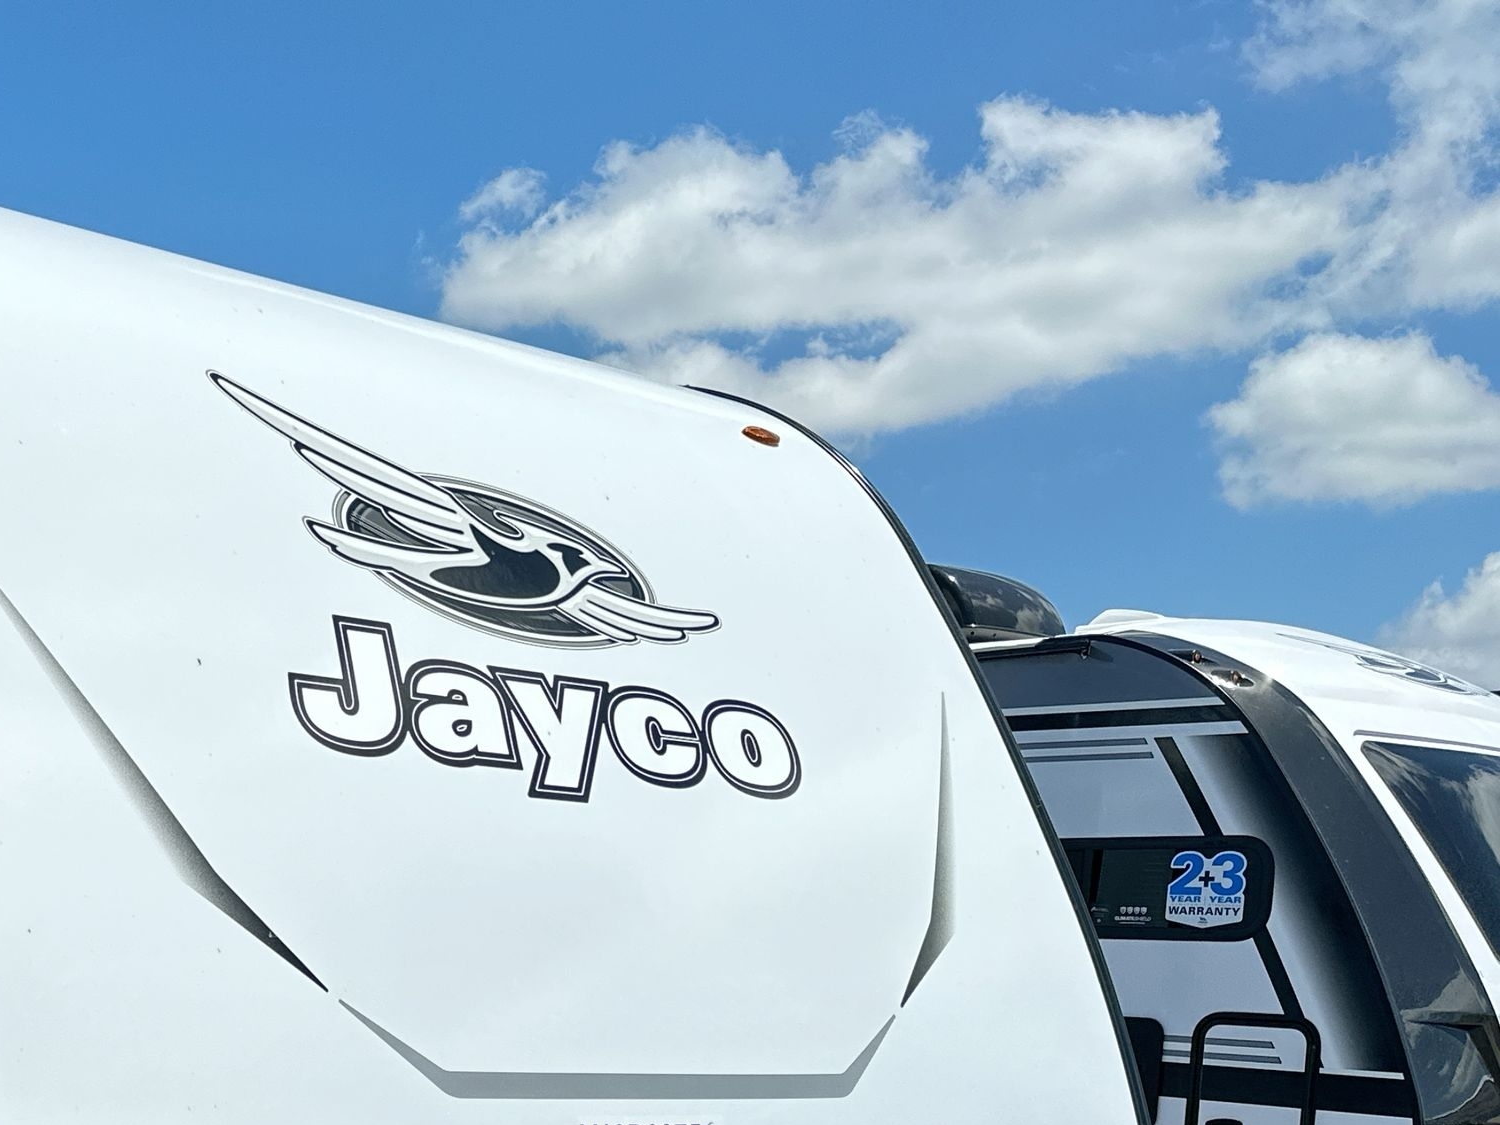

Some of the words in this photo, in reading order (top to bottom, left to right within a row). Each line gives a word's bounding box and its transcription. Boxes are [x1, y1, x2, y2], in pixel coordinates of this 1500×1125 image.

[287, 614, 802, 803] Jayco
[1169, 895, 1201, 903] YEAR
[1209, 895, 1241, 904] YEAR
[1168, 906, 1240, 916] WARRANTY
